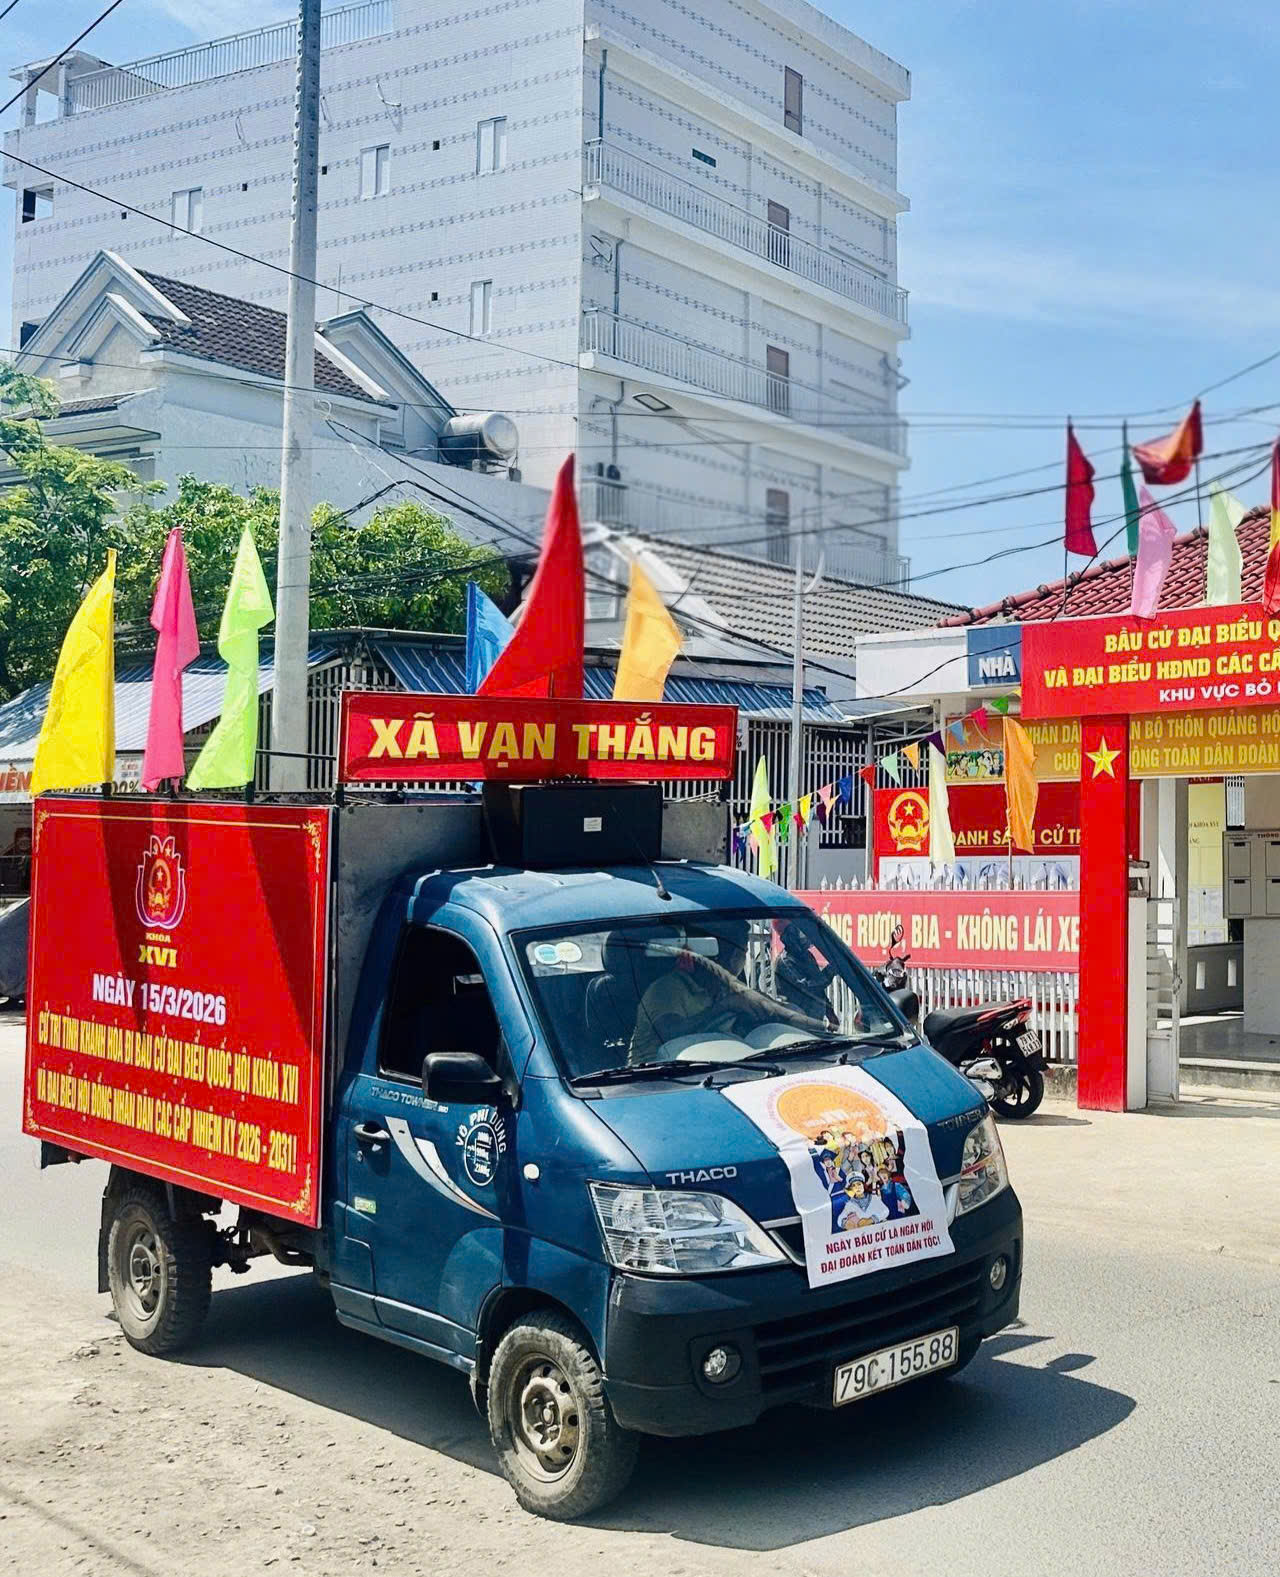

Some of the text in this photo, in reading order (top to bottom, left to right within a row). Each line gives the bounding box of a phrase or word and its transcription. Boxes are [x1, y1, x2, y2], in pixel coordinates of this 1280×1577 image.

[1105, 627, 1142, 653] BẦU
[1148, 625, 1174, 649] CỬ
[1178, 626, 1211, 649] ĐẠI
[1216, 613, 1262, 644] BIỂU
[979, 650, 1016, 677] NHÀ
[1044, 666, 1068, 689] VÀ
[1073, 670, 1104, 689] ĐẠI
[1108, 656, 1151, 684] BIỂU
[1156, 658, 1211, 679] HĐND
[1216, 652, 1253, 675] CÁC
[1159, 688, 1195, 703] KHU
[1201, 684, 1240, 701] VỰC
[1245, 678, 1272, 696] BỎ
[368, 712, 716, 768] XÃ VẠN THẮNG
[1062, 720, 1080, 743] DÂ
[1145, 716, 1163, 742] BỘ
[1167, 714, 1203, 738] THÔN
[1208, 709, 1257, 738] QUẢNG
[1055, 748, 1080, 774] CUỘ
[1132, 746, 1160, 772] ỘNG
[1163, 744, 1200, 767] TOÀN
[1204, 742, 1234, 765] DÂN
[1238, 740, 1279, 764] ĐOÀN
[1040, 824, 1064, 845] CỬ
[1068, 829, 1081, 844] TR
[821, 902, 852, 948] ỐNG
[911, 914, 940, 950] BIA
[945, 930, 952, 938] -
[957, 907, 1018, 951] KHÔNG
[1023, 907, 1052, 951] LÁI
[1058, 915, 1080, 953] XE
[138, 944, 177, 968] XVI
[92, 971, 226, 1026] NGÀY 15/3/2026
[49, 1013, 61, 1047] TRI
[62, 1005, 80, 1051] TỈNH
[80, 1016, 107, 1057] KHÁNH
[107, 1019, 123, 1061] HÒA
[125, 1030, 133, 1063] ĐI
[135, 1025, 152, 1069] BẦU
[154, 1025, 167, 1072] CỬ
[167, 1039, 182, 1084] ĐẠI
[184, 1029, 205, 1082] BIỂU
[207, 1037, 232, 1088] QUỐC
[234, 1047, 250, 1101] HỘI
[252, 1052, 279, 1098] KHÓA
[282, 1064, 299, 1104] XVI
[113, 1083, 135, 1128] NHÂN
[136, 1088, 154, 1132] DÂN
[155, 1093, 172, 1135] CÁC
[173, 1093, 192, 1142] CẤP
[192, 1105, 223, 1158] NHIỆM
[237, 1123, 261, 1164] 2026
[268, 1128, 297, 1175] 2031!
[665, 1166, 738, 1184] THACO
[820, 1259, 837, 1274] ĐẠI
[840, 1333, 954, 1400] 79C-155.88
